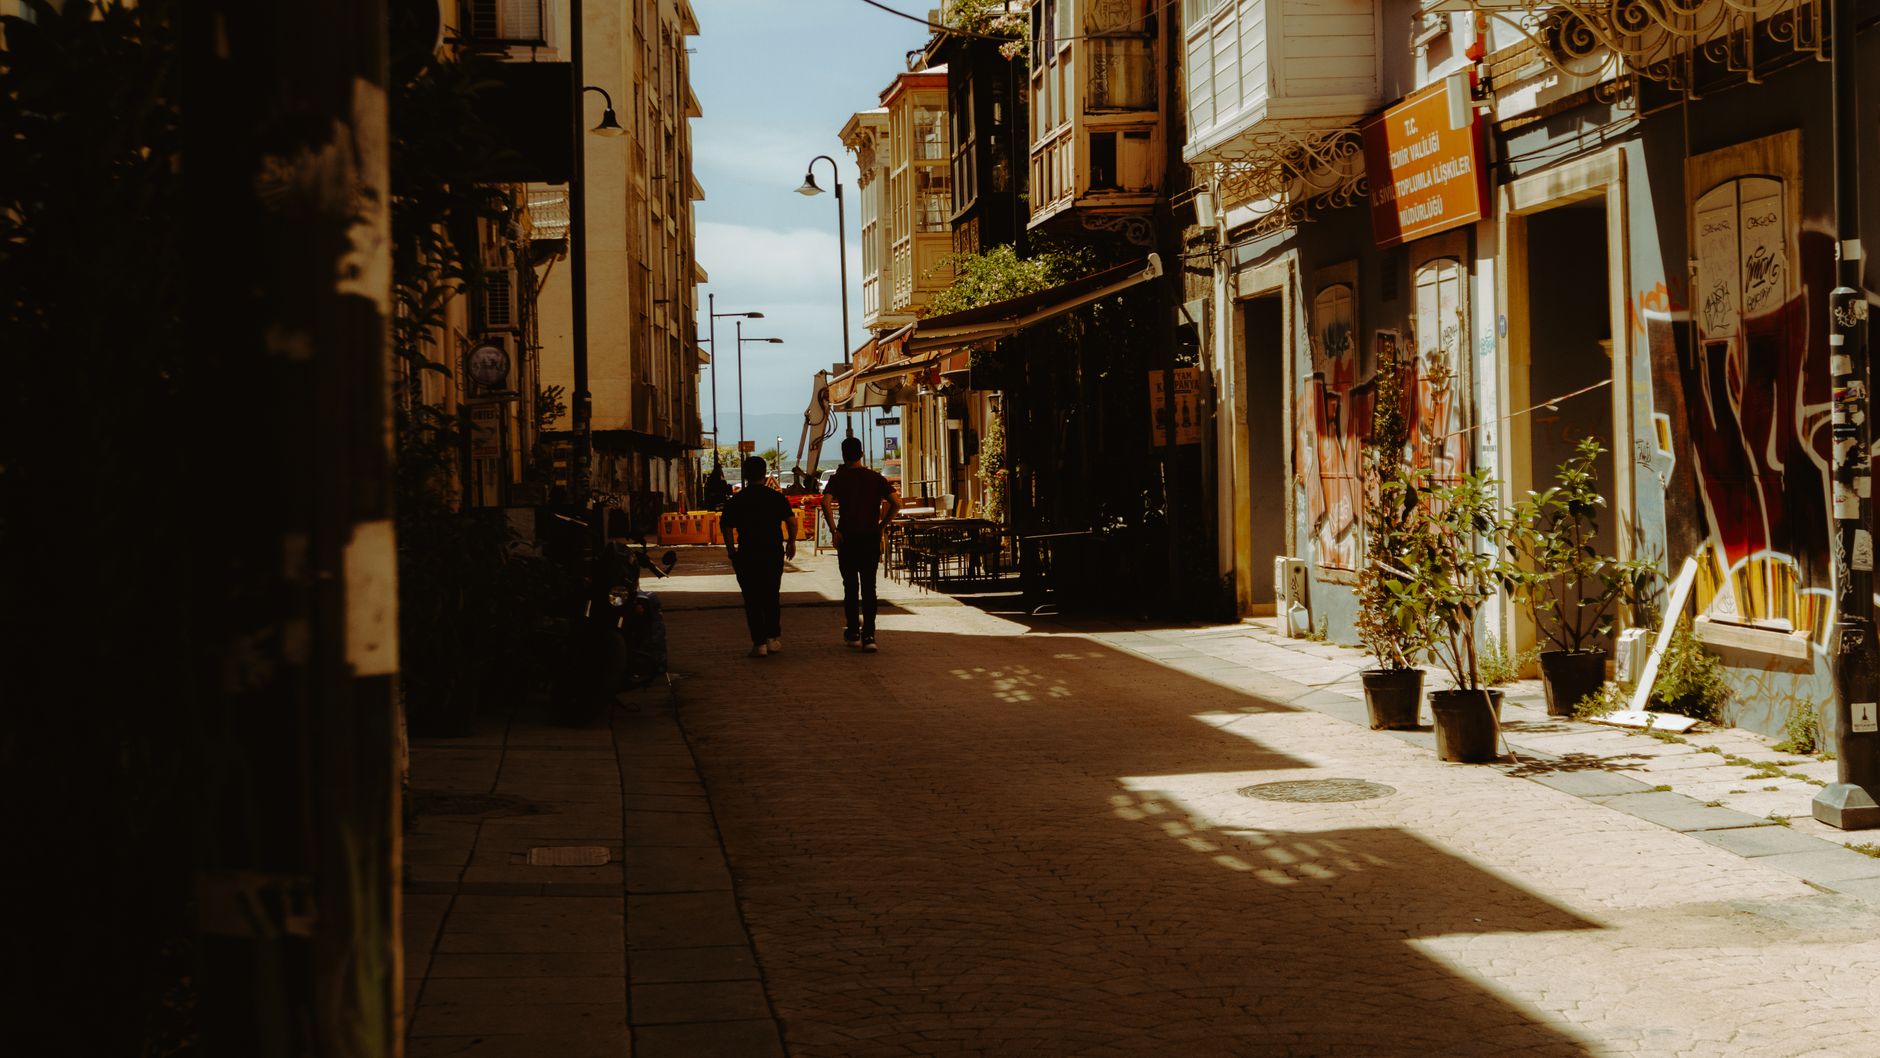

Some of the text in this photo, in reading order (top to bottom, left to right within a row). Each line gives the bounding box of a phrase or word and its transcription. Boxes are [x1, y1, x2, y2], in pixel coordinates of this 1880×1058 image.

[1404, 117, 1419, 137] T.C.
[1389, 130, 1440, 169] İZMİR VALİLİĞİ
[1396, 172, 1433, 198] TOPLUMLA
[1432, 155, 1471, 186] İLİŞKİLER
[1399, 194, 1443, 226] MÜDÜRLÜĞÜ
[885, 438, 893, 449] P
